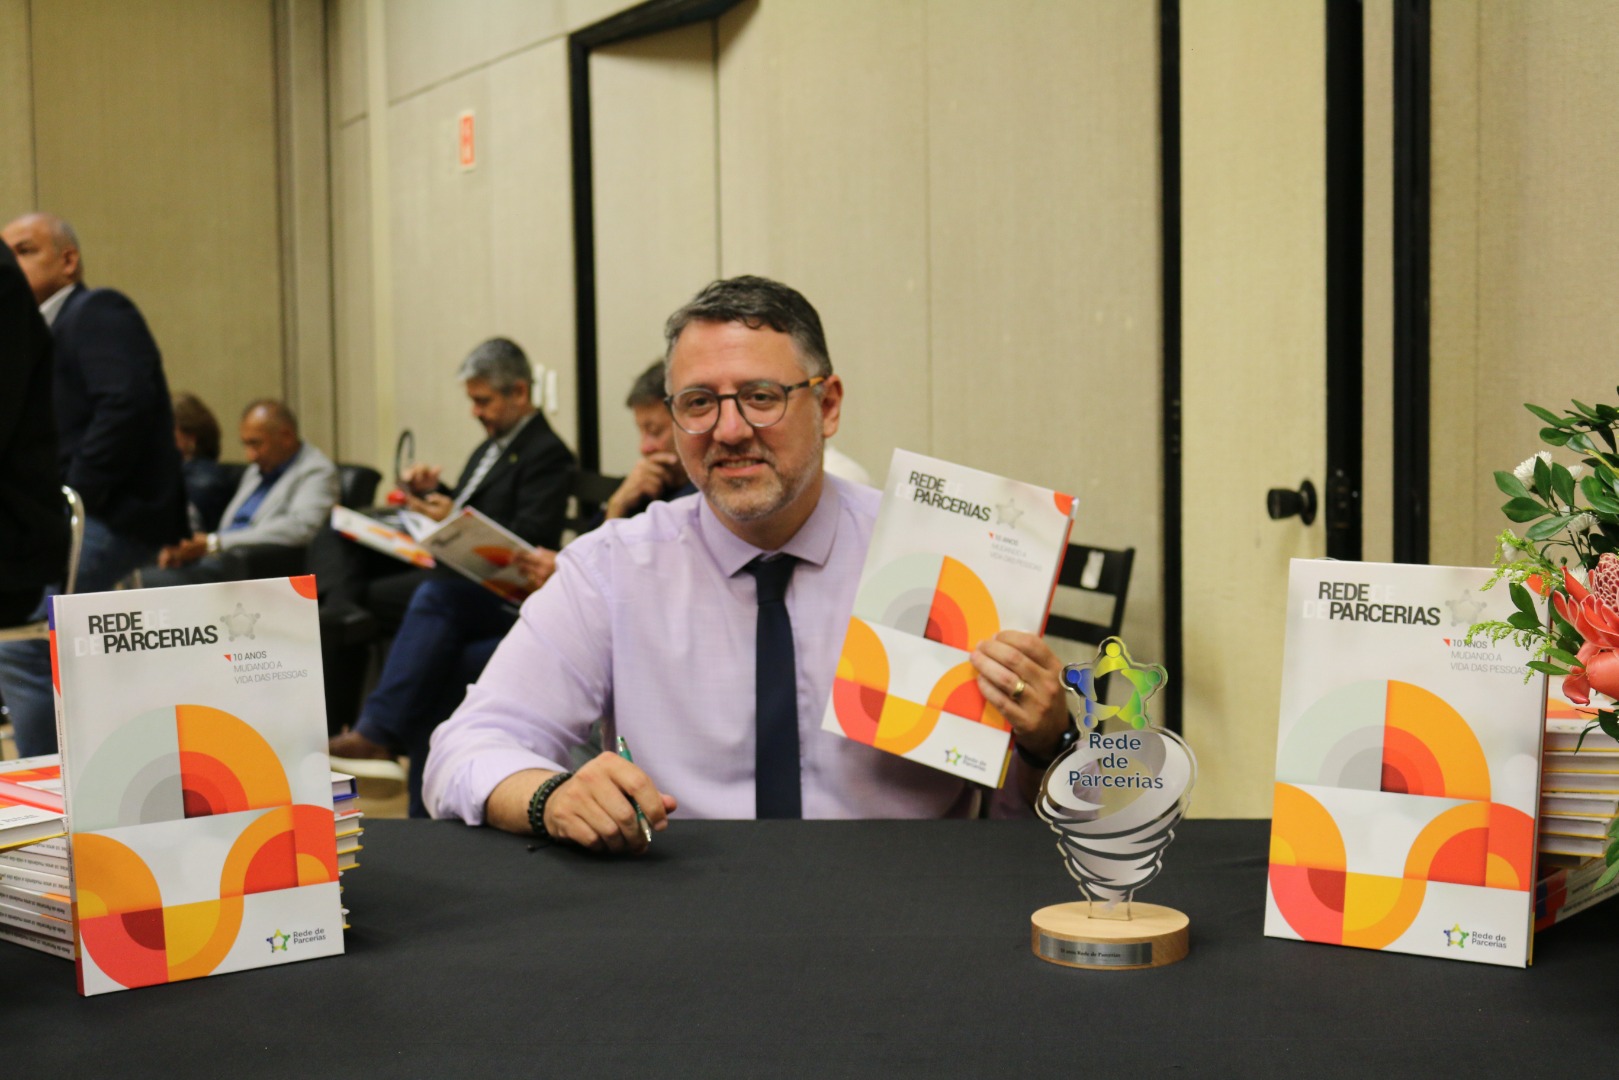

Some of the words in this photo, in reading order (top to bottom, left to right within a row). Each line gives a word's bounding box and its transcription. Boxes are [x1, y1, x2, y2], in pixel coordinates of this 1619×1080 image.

[909, 470, 946, 493] REDE
[913, 488, 991, 522] PARCERIAS
[1318, 581, 1370, 602] REDE
[1329, 602, 1441, 626] PARCERIAS
[88, 611, 143, 635] REDE
[103, 625, 219, 654] PARCERIAS
[1452, 639, 1462, 648] 10
[233, 653, 243, 661] 10
[244, 650, 267, 660] ANOS
[1451, 650, 1495, 661] MUDANDO
[1496, 653, 1502, 662] A
[233, 661, 276, 673] MUDANDO
[1450, 662, 1470, 671] VIDA
[1471, 663, 1488, 673] DAS
[234, 674, 254, 685] VIDA
[272, 669, 308, 681] PESSOAS
[1089, 733, 1142, 751] Rede
[1102, 752, 1129, 769] de
[1068, 770, 1164, 790] Parcerias
[293, 930, 313, 939] Rede
[314, 927, 325, 935] de
[293, 933, 326, 945] Parcerias
[1472, 931, 1493, 941] Rede
[1495, 933, 1507, 942] de
[1471, 938, 1508, 949] Parcerias
